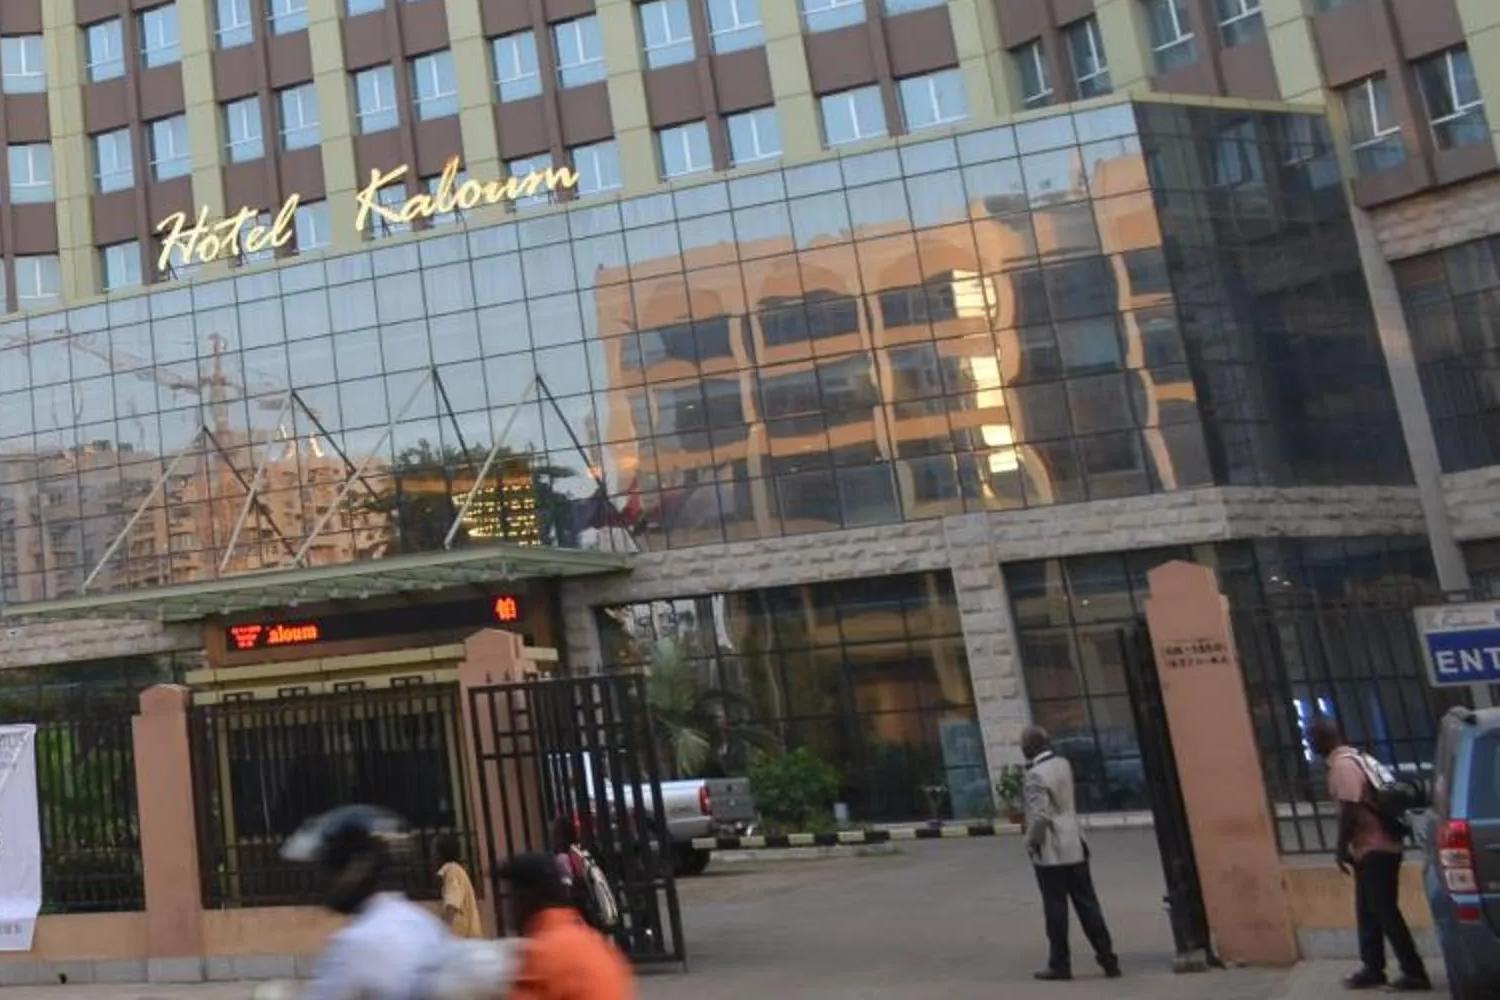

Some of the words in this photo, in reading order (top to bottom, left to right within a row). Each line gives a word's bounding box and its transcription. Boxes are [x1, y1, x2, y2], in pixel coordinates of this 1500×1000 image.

[156, 193, 300, 271] Hotel
[355, 155, 580, 231] Kaloum
[264, 625, 318, 643] aloum
